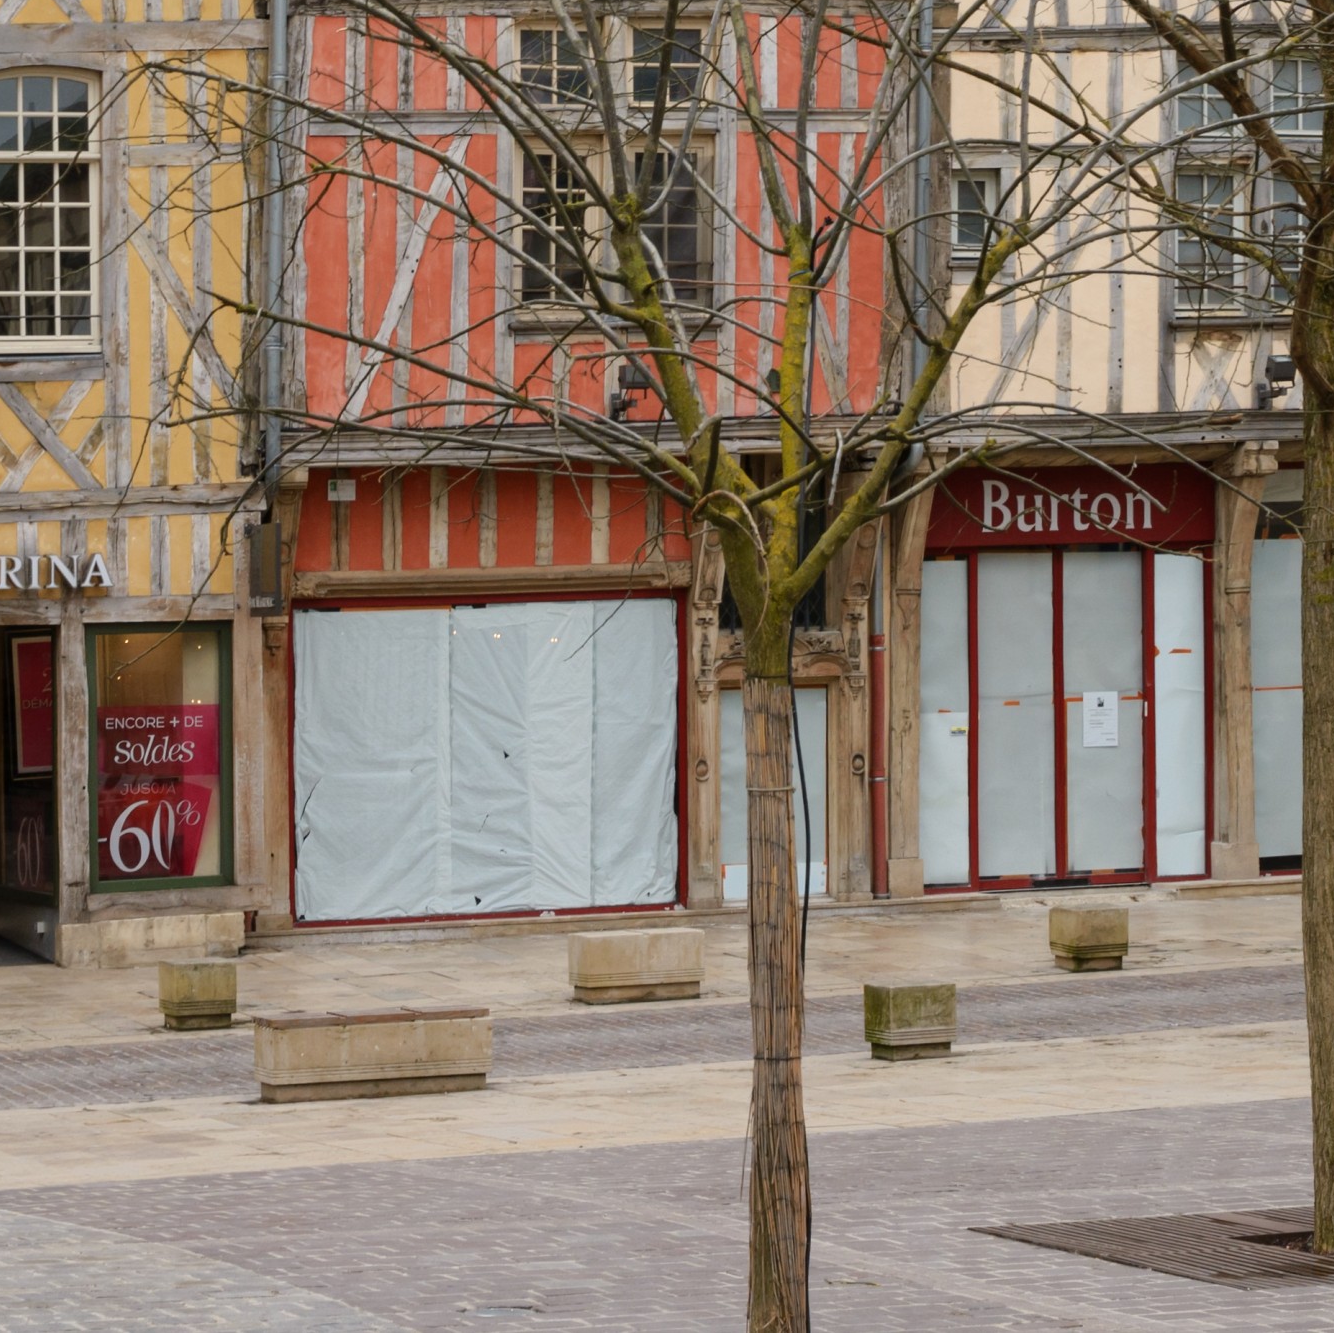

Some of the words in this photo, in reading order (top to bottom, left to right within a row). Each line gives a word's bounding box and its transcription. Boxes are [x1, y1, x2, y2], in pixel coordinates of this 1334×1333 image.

[981, 479, 1153, 533] Burton
[105, 716, 166, 730] ENCORE
[184, 715, 204, 728] DE
[114, 734, 195, 767] soldes
